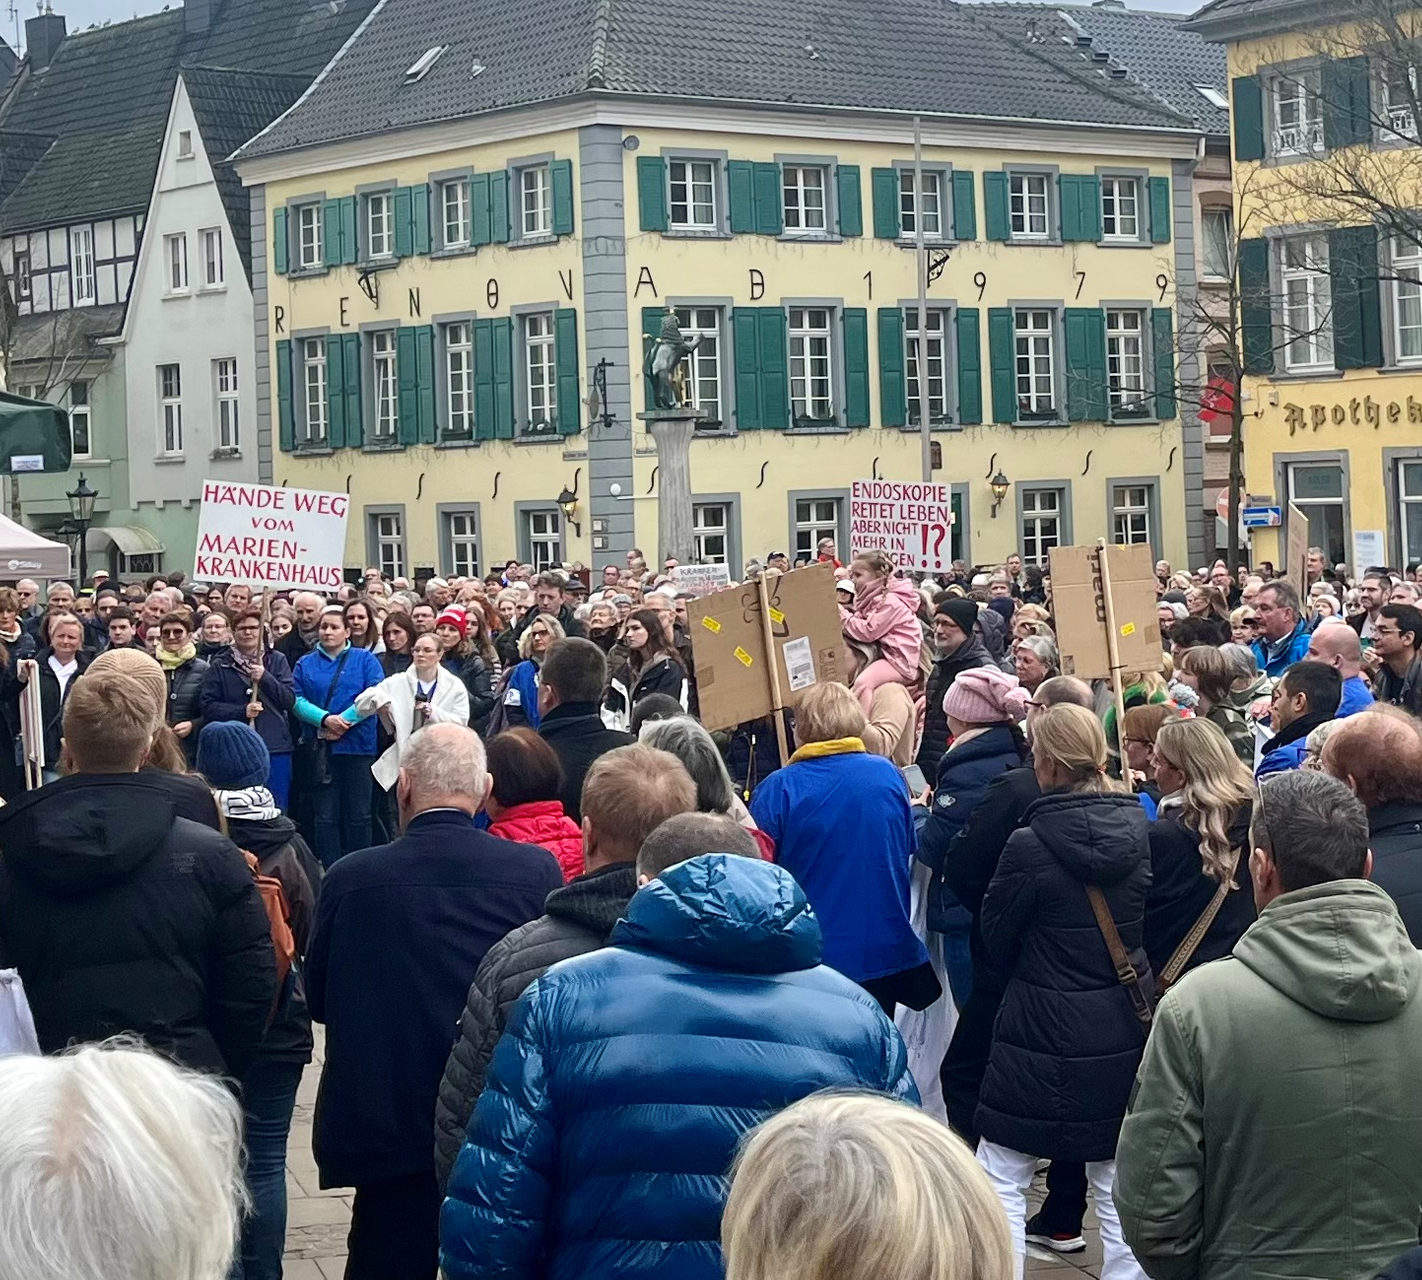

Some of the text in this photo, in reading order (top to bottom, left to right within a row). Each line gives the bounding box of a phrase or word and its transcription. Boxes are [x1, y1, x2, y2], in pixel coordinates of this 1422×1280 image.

[204, 484, 347, 518] HÄNDE WEG
[852, 482, 947, 502] ENDOSKOPIE
[252, 517, 294, 532] VOM
[852, 501, 950, 527] RETTET LEBEN,
[851, 520, 918, 535] ABER NICHT
[199, 533, 307, 559] MARIEN-
[851, 535, 905, 550] MEHR IN
[921, 524, 945, 569] !?
[197, 555, 341, 587] KRANKENHAUS
